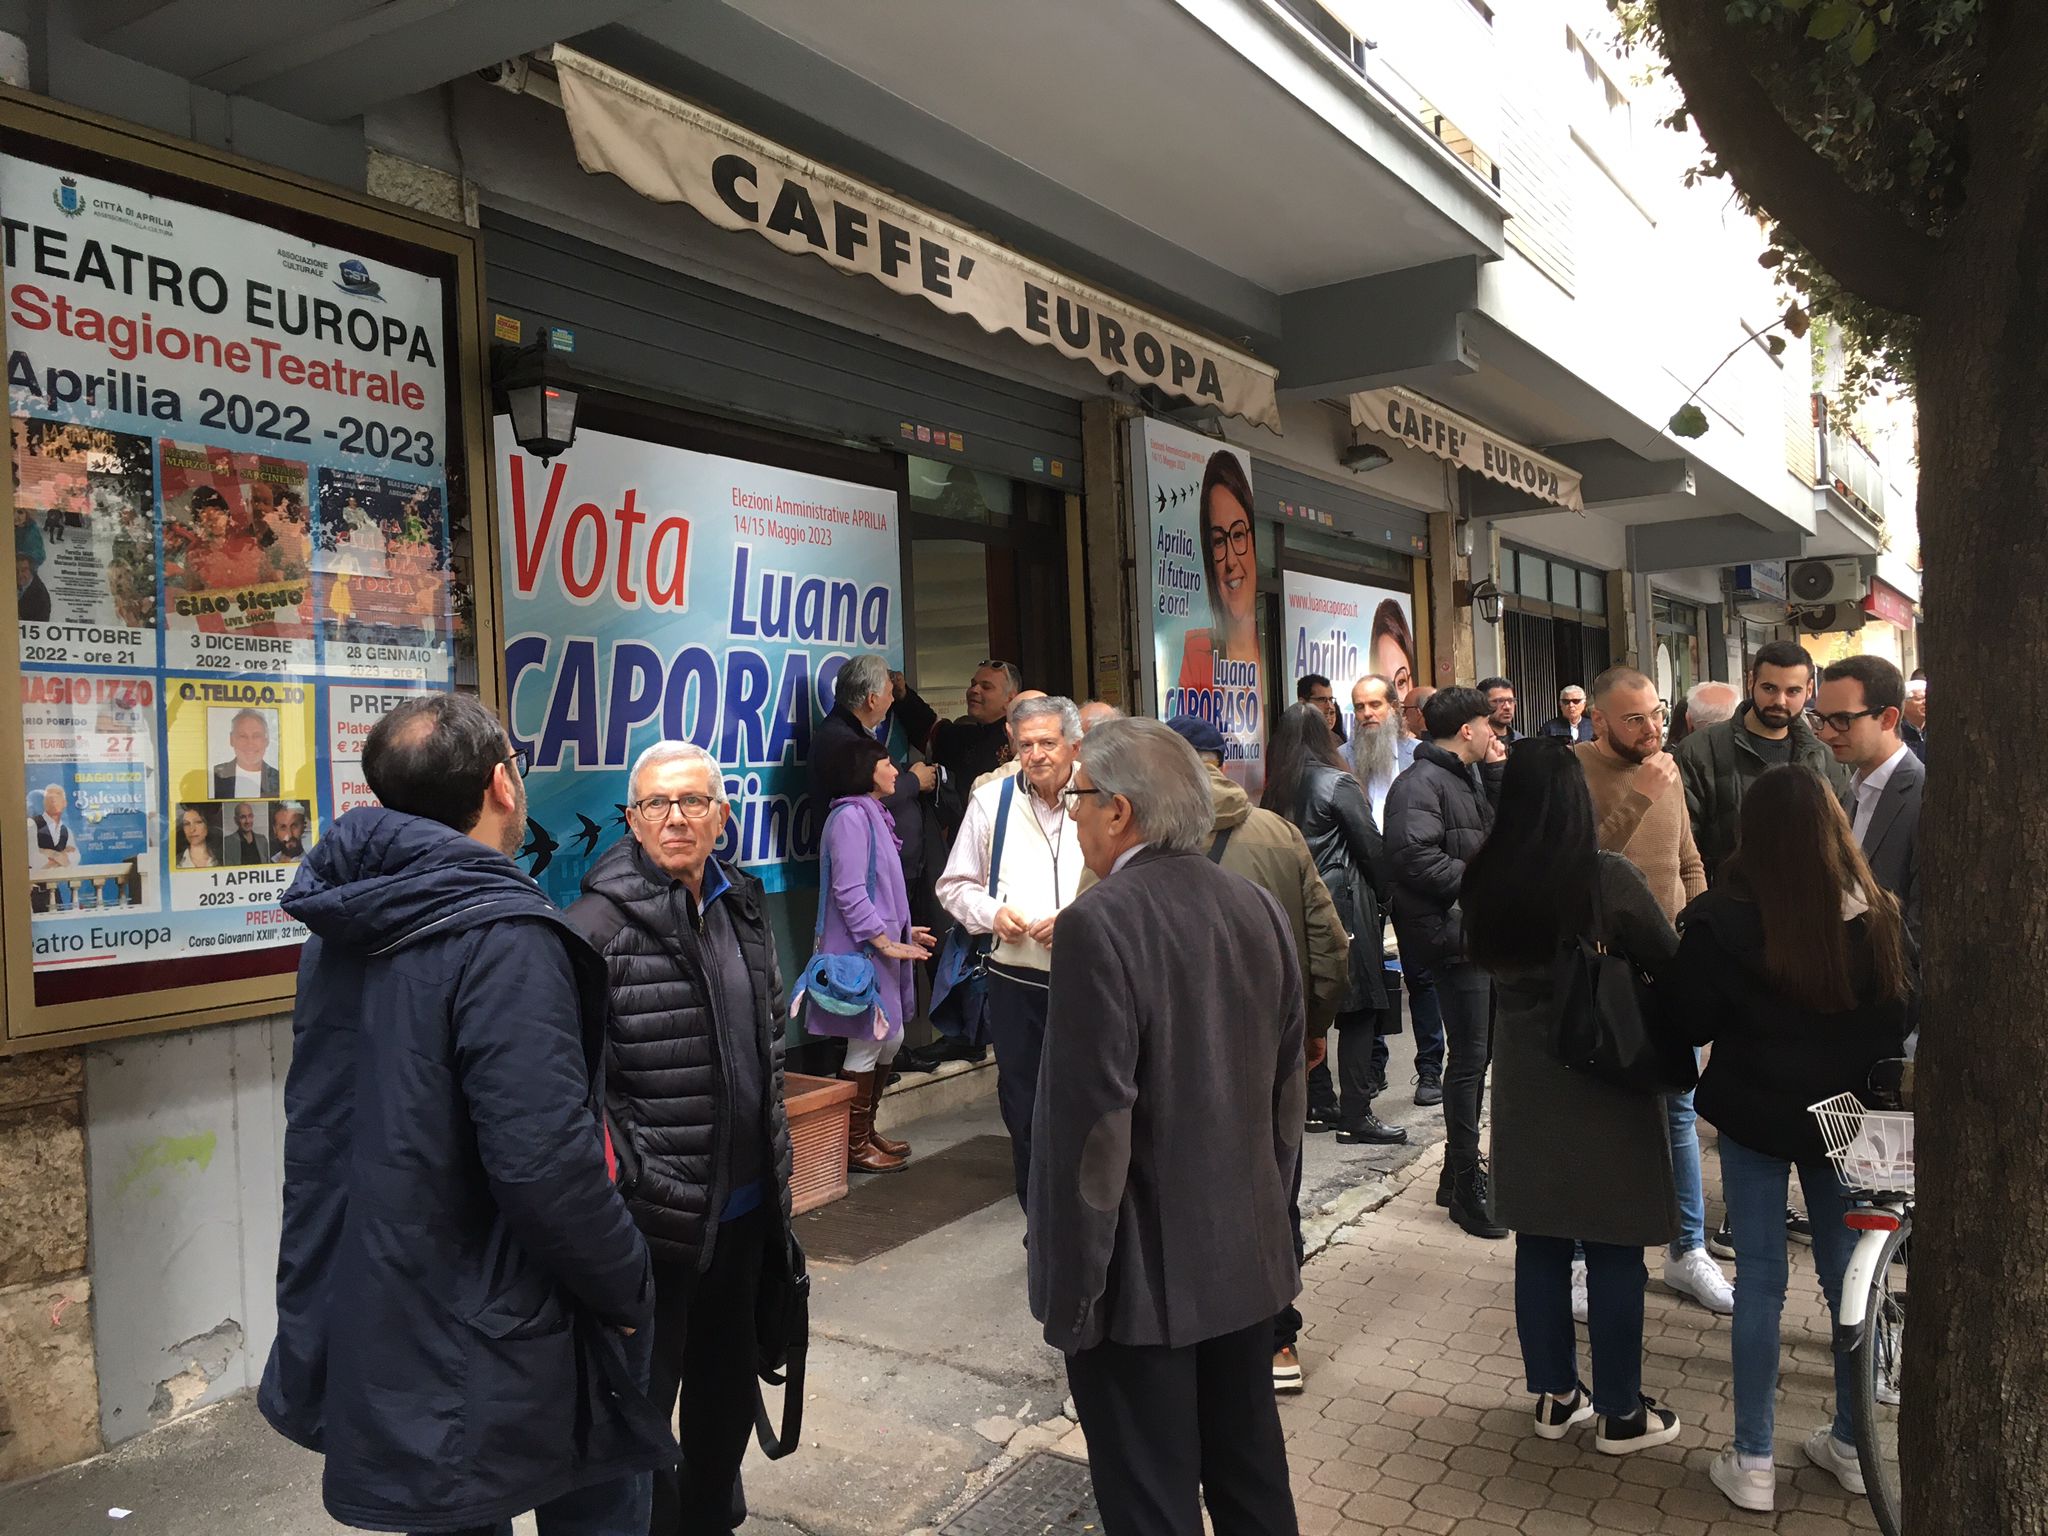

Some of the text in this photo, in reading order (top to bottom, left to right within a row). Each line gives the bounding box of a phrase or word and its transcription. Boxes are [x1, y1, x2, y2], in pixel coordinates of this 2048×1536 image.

[92, 199, 173, 229] CITTÀ DI APRILIA
[277, 249, 328, 270] ASSOCIAZIONE
[282, 260, 324, 278] CULTURALE
[711, 153, 1225, 405] CAFFE' EUROPA
[1, 217, 437, 369] TEATRO EUROPA
[8, 350, 183, 422] Aprilia
[200, 388, 311, 445] 2022
[1387, 399, 1560, 498] CAFFE' EUROPA
[732, 487, 773, 512] Elezioni
[776, 495, 850, 525] Amministrative
[852, 509, 887, 531] APRILIA
[509, 454, 690, 607] Vota
[734, 514, 832, 546] 14/15 Maggio 2023
[1157, 524, 1196, 561] Aprilia,
[1158, 558, 1201, 591] il futuro
[729, 547, 889, 646] Luana
[1158, 587, 1189, 617] è ora!
[1288, 592, 1358, 619] www.luanacaporaso.it
[224, 611, 275, 627] LIVE SHOW
[20, 625, 142, 645] 15 OTTOBRE
[190, 634, 293, 653] 3 DICEMBRE
[25, 646, 67, 661] 2022
[84, 651, 112, 663] ore
[117, 651, 135, 664] 21
[196, 654, 231, 668] 2022
[244, 660, 268, 670] ore
[272, 659, 288, 671] 21
[347, 646, 431, 663] 28 GENNAIO
[350, 664, 380, 677] 2023
[392, 666, 412, 678] ore
[1214, 650, 1256, 687] Luana
[96, 679, 153, 707] IZZO
[22, 717, 87, 726] RIO PORFIDO
[1165, 687, 1258, 734] CAPORASO
[337, 721, 373, 734] Plate
[1224, 737, 1260, 760] Sindaca
[211, 869, 285, 886] 1 APRILE
[200, 892, 234, 906] 2023
[249, 890, 272, 902] ore
[32, 927, 171, 954] atro Europa
[189, 935, 215, 948] Corso
[217, 930, 254, 945] Giovanni
[281, 927, 291, 938] 32
